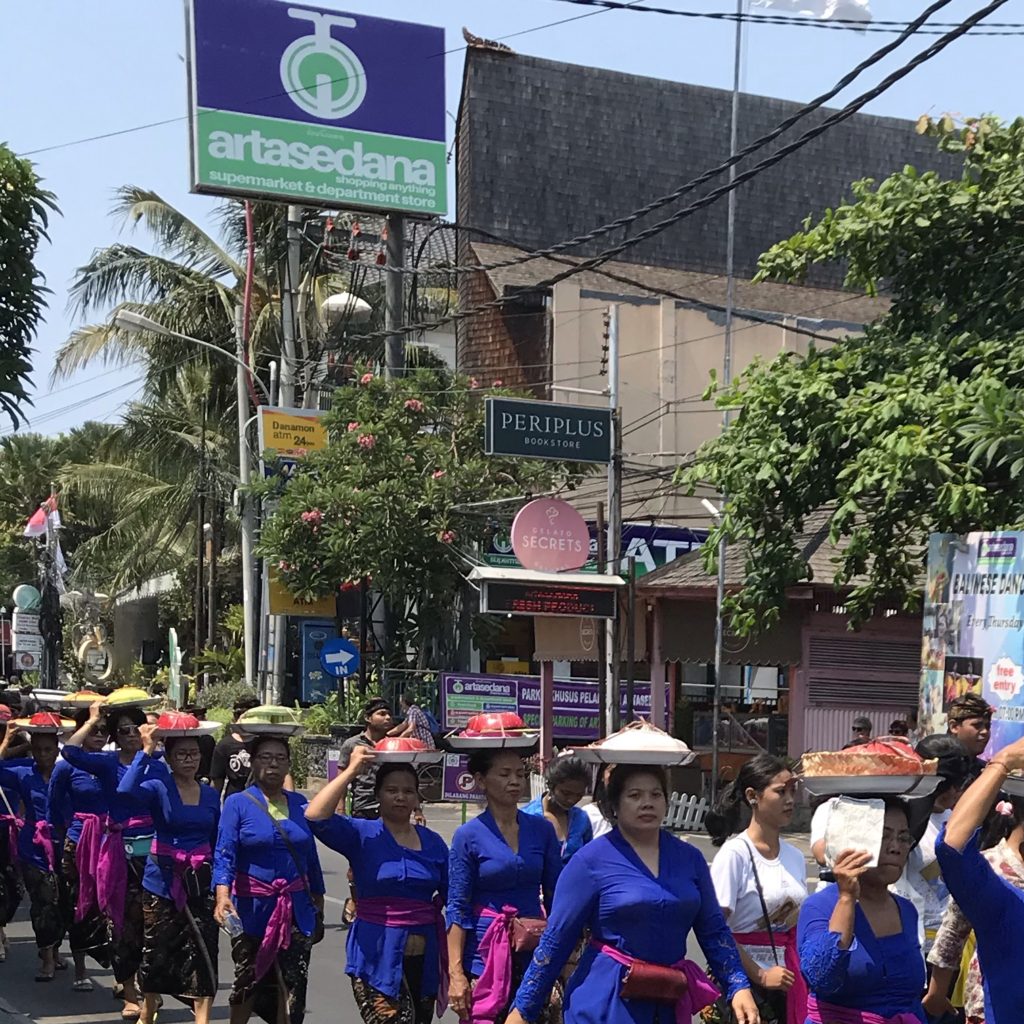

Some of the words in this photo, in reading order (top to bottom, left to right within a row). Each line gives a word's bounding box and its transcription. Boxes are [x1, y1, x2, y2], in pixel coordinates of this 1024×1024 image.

[208, 130, 436, 187] artasedana
[208, 168, 304, 193] supermarket
[305, 181, 315, 194] &
[316, 183, 400, 204] department
[401, 194, 436, 209] store
[335, 174, 387, 190] shopping
[388, 182, 436, 197] anything
[272, 420, 315, 433] Danamon
[502, 412, 605, 438] PERIPLUS
[524, 436, 581, 449] BOOKSTORE
[531, 527, 573, 537] GELATO
[521, 535, 583, 553] SECRETS
[620, 537, 706, 574] AT
[952, 574, 998, 596] BALINESE
[966, 614, 988, 631] Every
[986, 614, 1024, 632] Thursday
[335, 665, 349, 676] IN
[996, 664, 1015, 678] free
[464, 682, 511, 693] artasedana
[521, 687, 541, 701] PARK
[993, 679, 1017, 695] entry
[523, 712, 540, 726] SPEC
